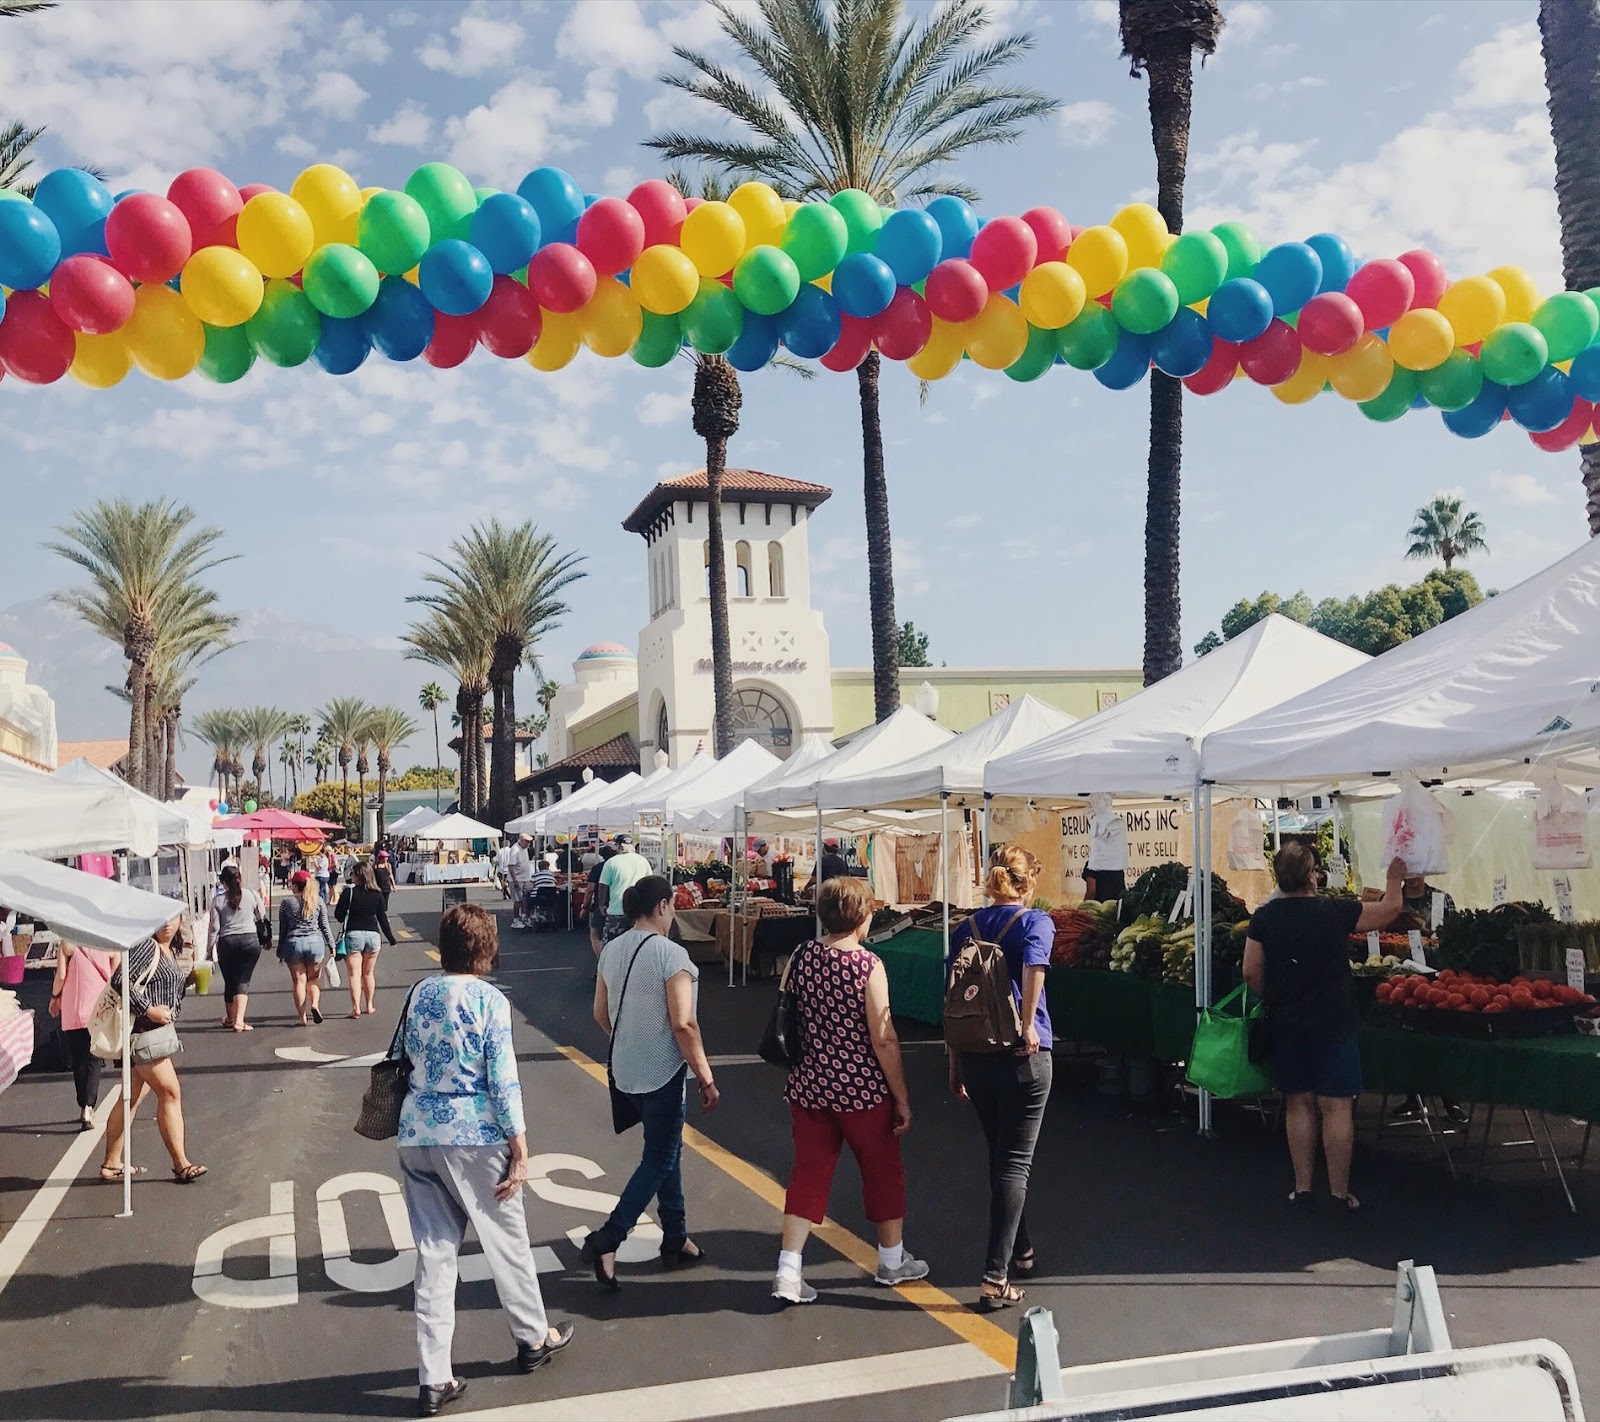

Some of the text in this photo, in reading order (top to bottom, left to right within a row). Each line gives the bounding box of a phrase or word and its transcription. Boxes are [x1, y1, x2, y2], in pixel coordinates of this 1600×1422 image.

[1156, 809, 1178, 831] INC
[1136, 842, 1150, 857] WE
[1154, 841, 1178, 857] SELL!
